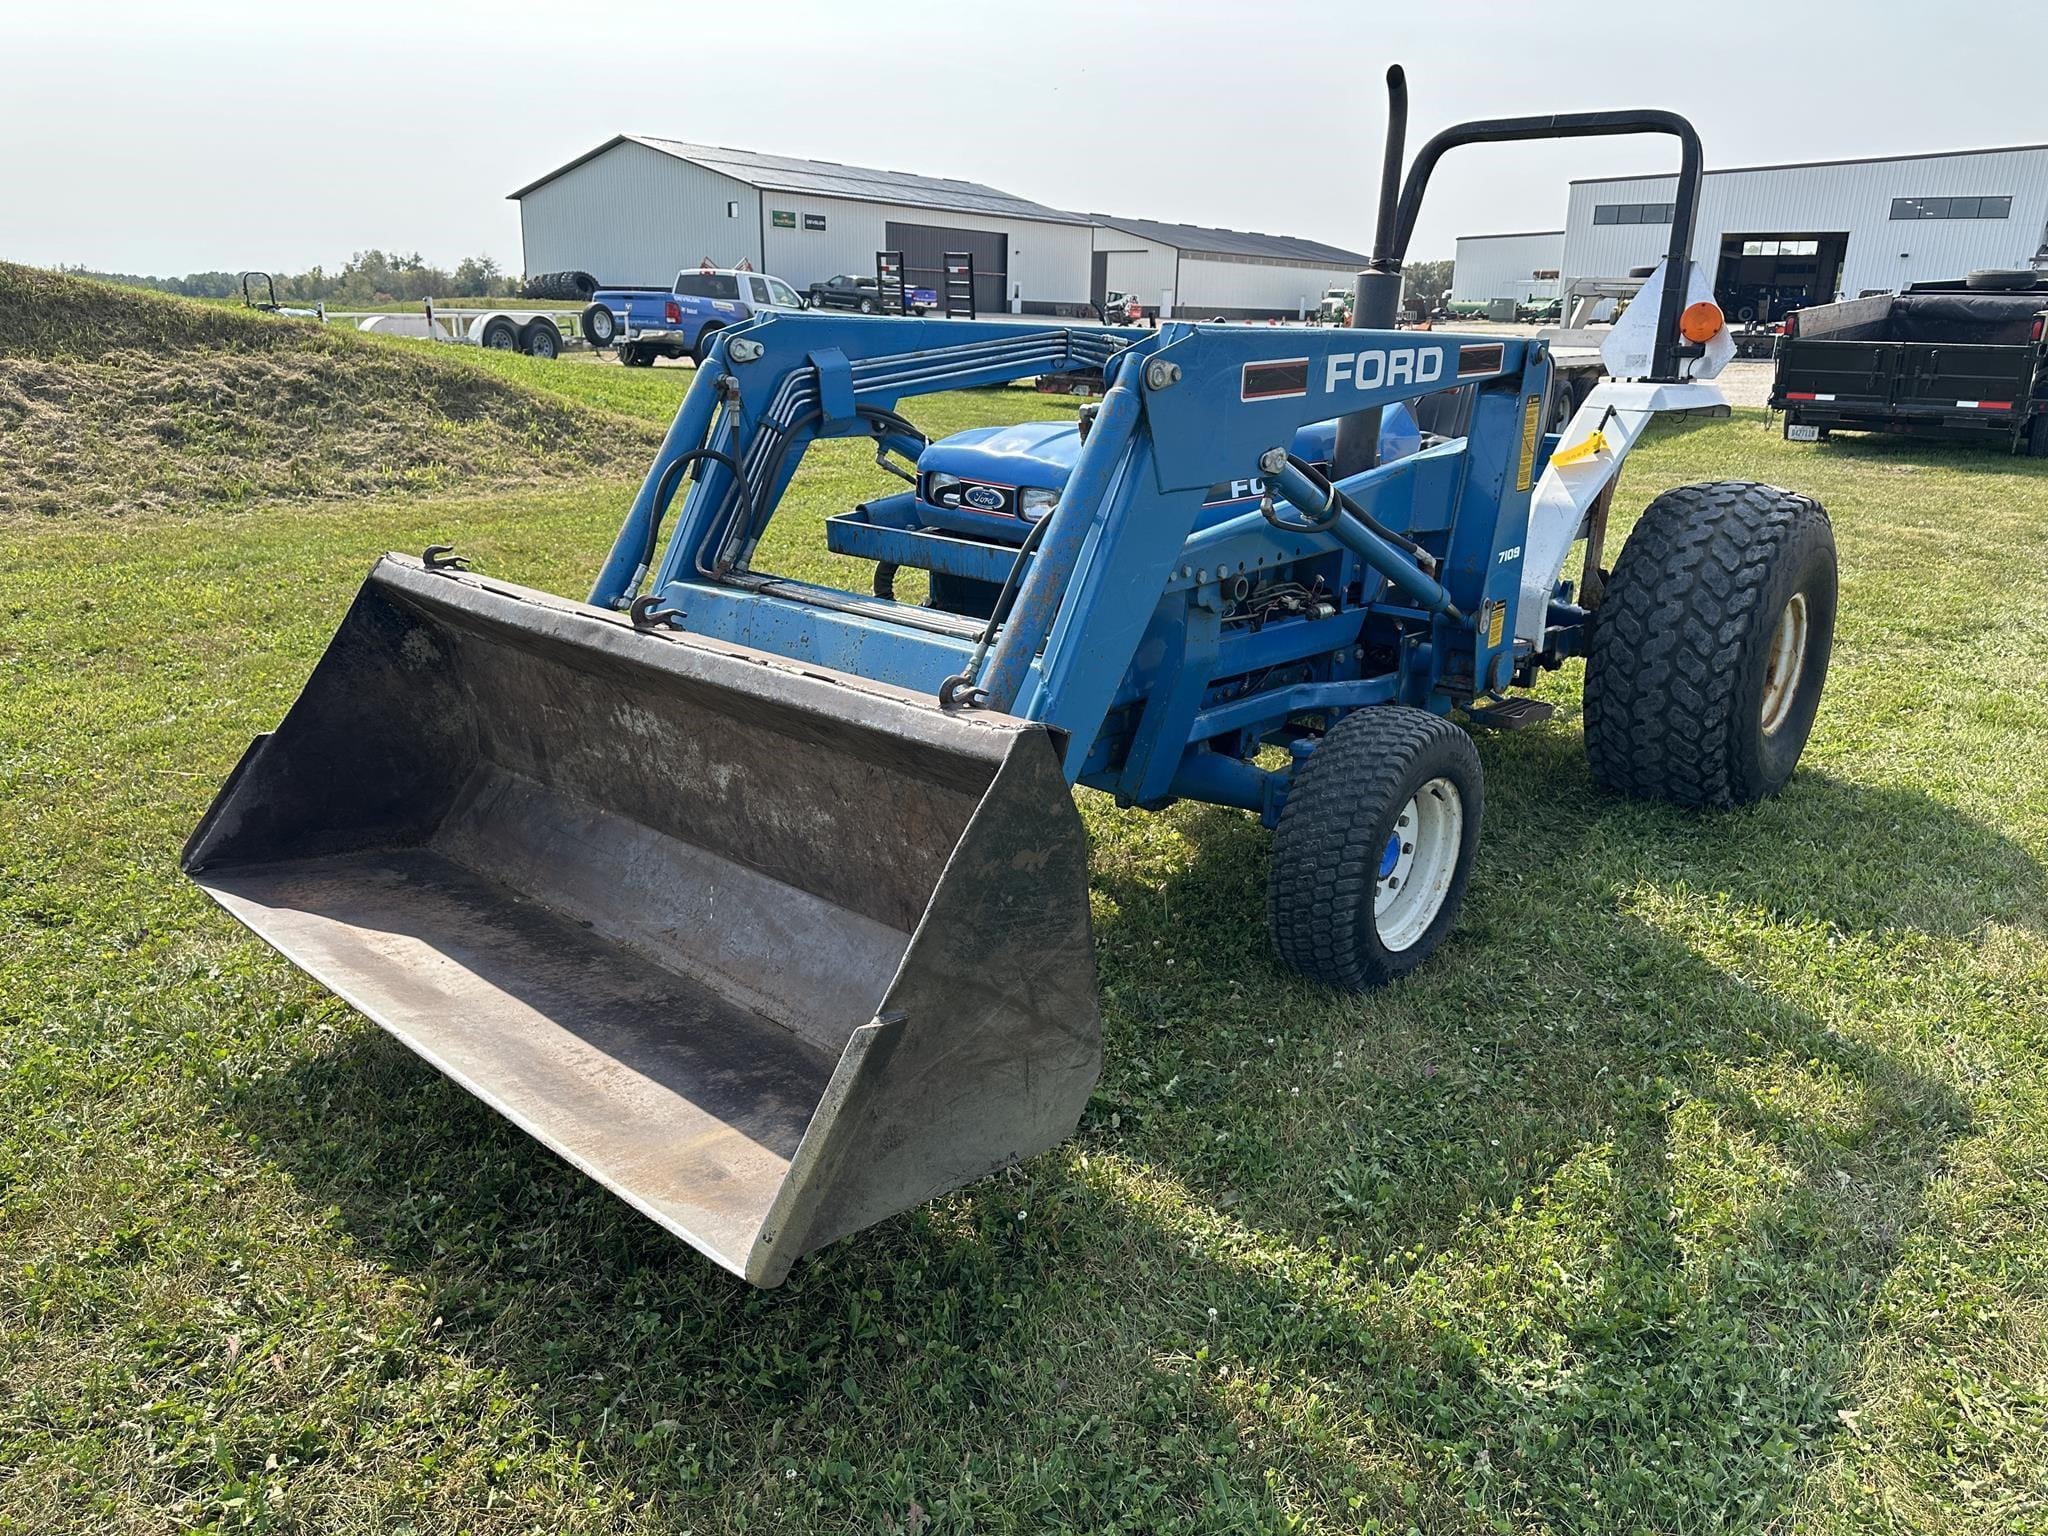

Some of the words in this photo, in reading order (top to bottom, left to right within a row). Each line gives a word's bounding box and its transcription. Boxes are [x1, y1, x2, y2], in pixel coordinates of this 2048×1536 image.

[1325, 346, 1444, 393] FORD
[1231, 477, 1266, 498] FO
[973, 491, 995, 505] Ford
[1498, 546, 1521, 564] 7109
